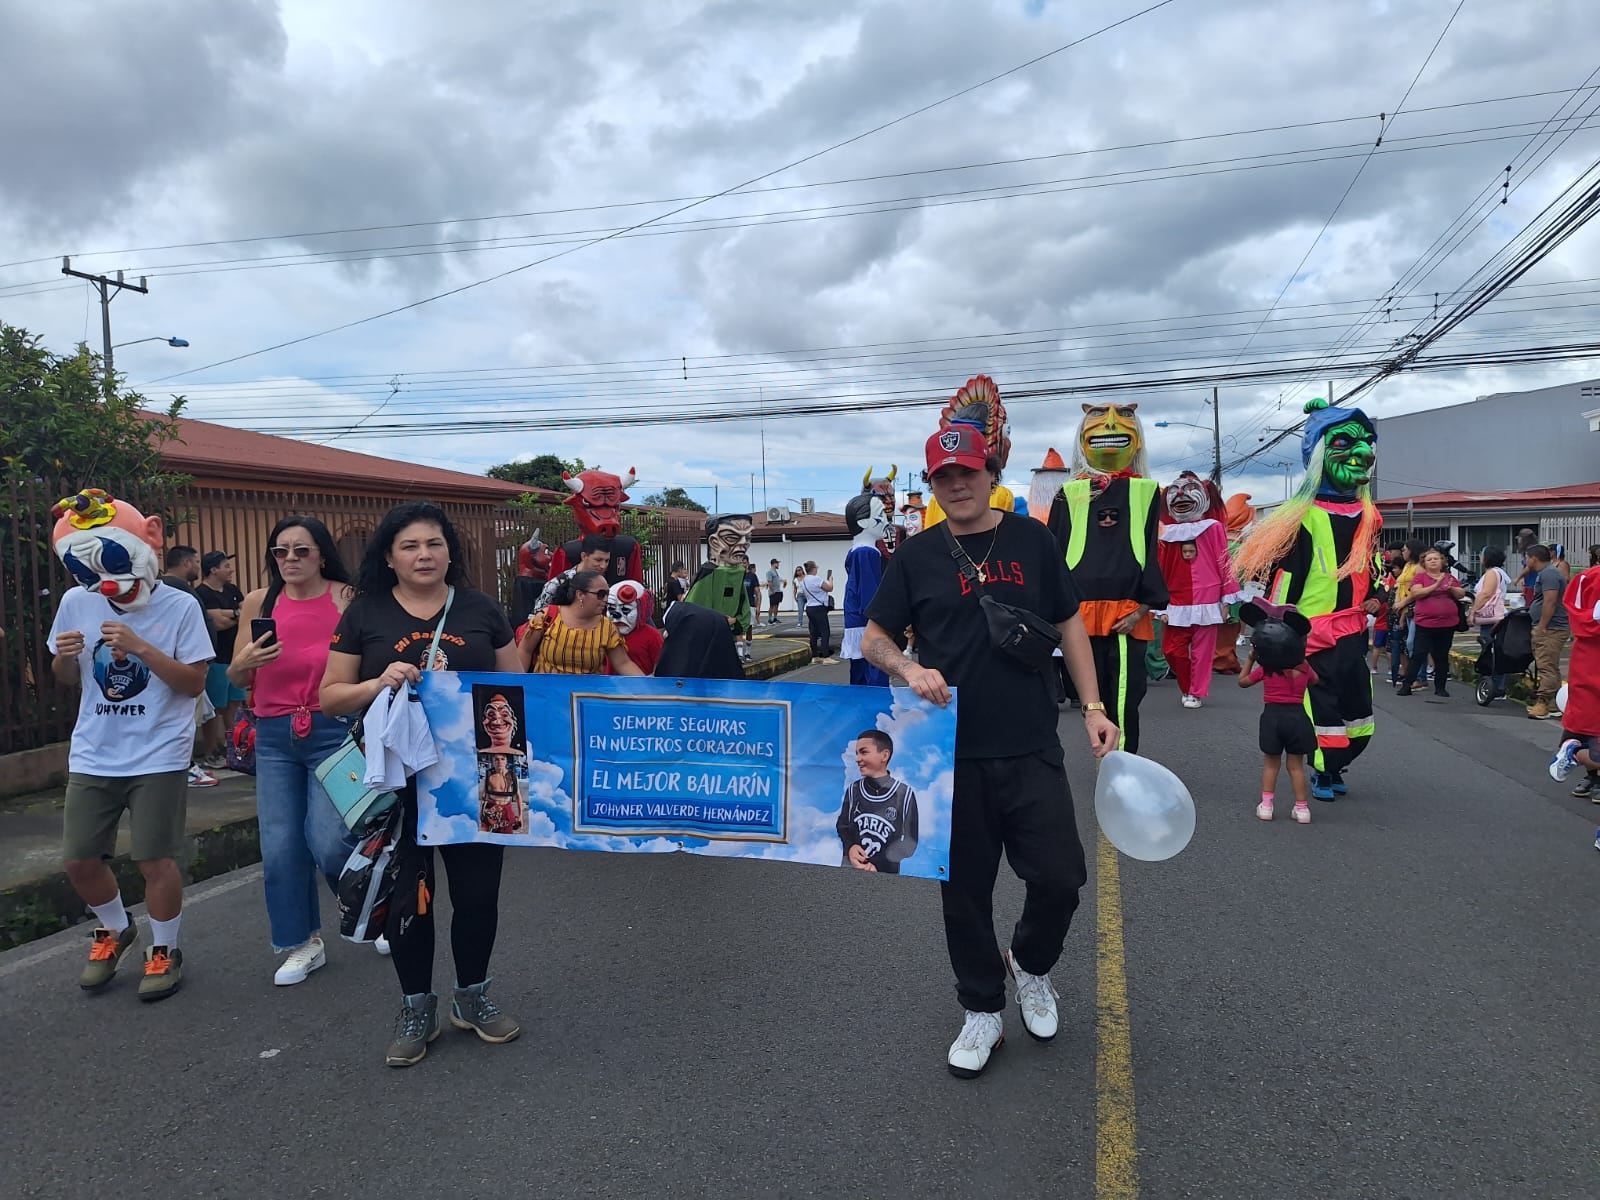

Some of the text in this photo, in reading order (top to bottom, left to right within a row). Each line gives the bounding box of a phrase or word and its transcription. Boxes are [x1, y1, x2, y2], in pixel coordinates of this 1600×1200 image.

[613, 715, 747, 737] SIEMPRE SEGUIRAS
[589, 735, 774, 758] EN NUESTROS CORAZONES
[592, 769, 771, 799] EL MEJOR BAILARÍN
[592, 802, 770, 823] JOHYNER VALVERDE HERNÁNDEZ
[857, 817, 891, 838] PARIS
